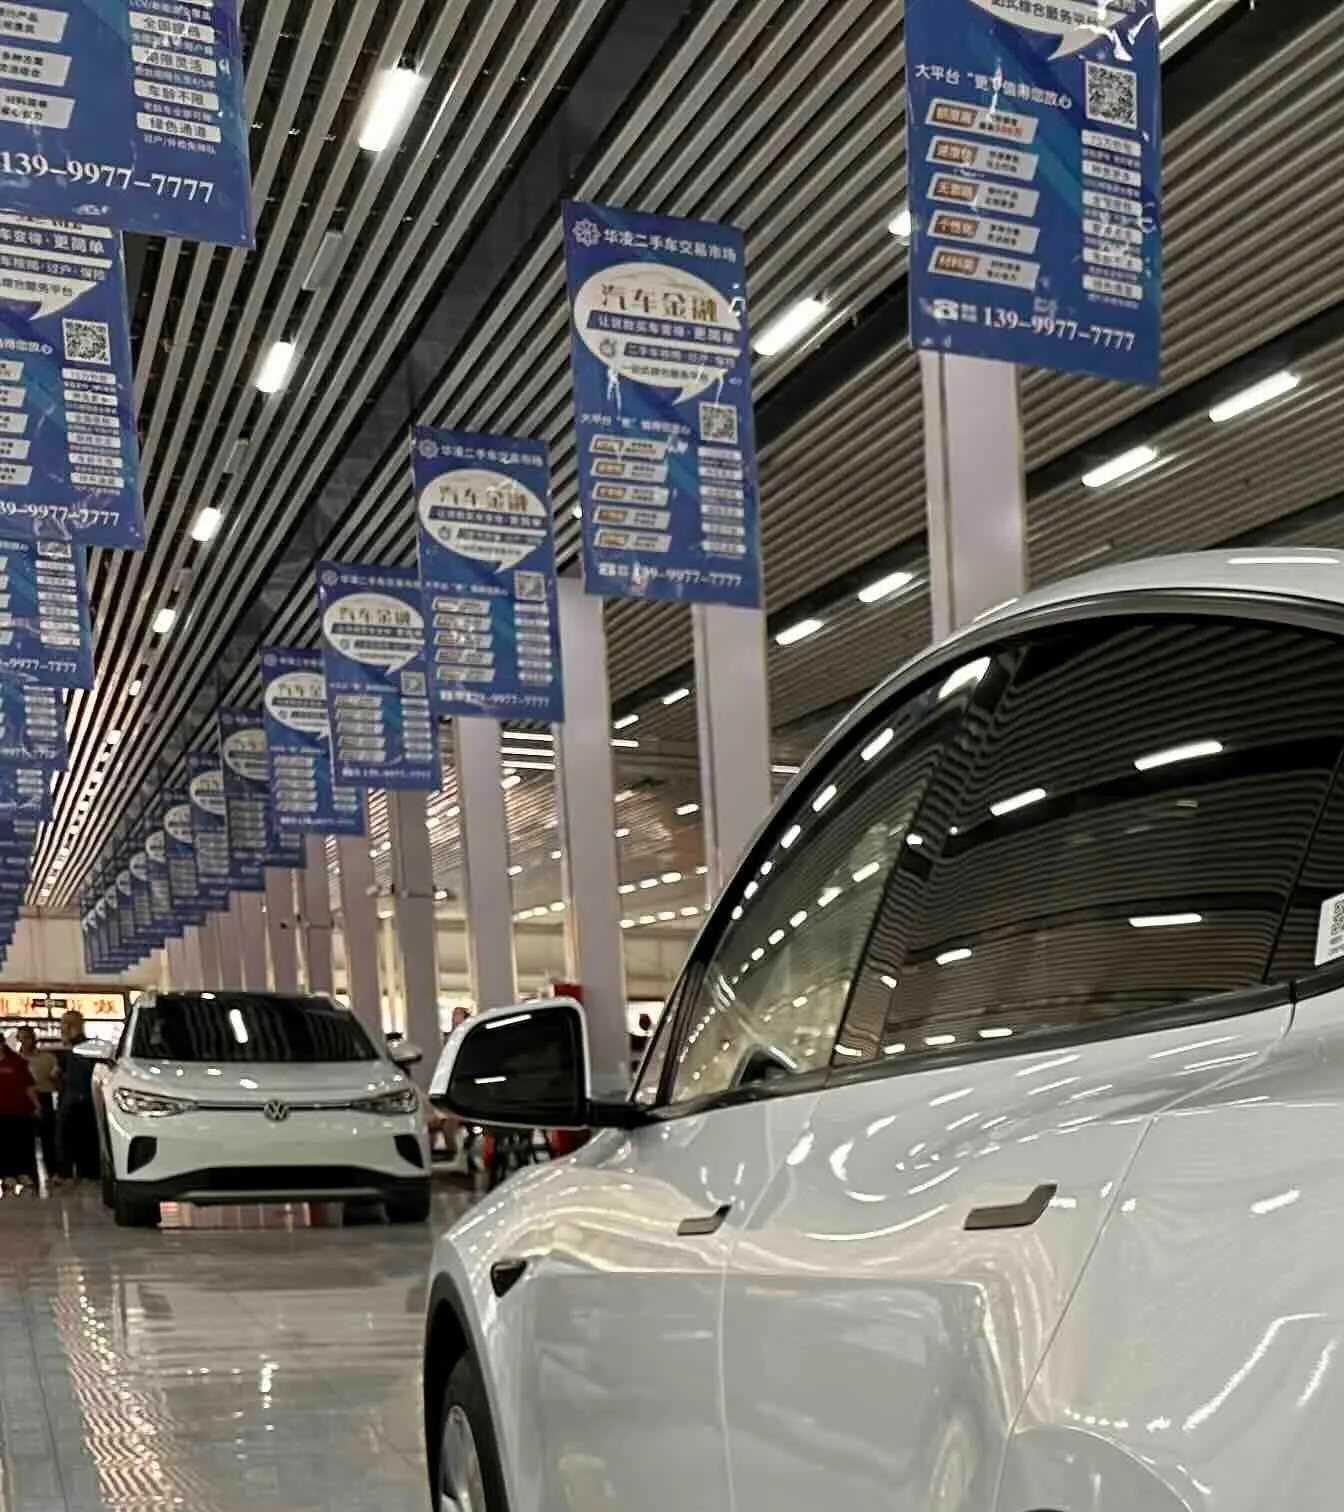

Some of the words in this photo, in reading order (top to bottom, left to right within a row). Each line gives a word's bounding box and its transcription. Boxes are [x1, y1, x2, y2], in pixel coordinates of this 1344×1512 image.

[1, 151, 214, 204] 139-9977-7777
[601, 283, 718, 322] 汽车金融
[984, 306, 1136, 351] 139-9977-7777
